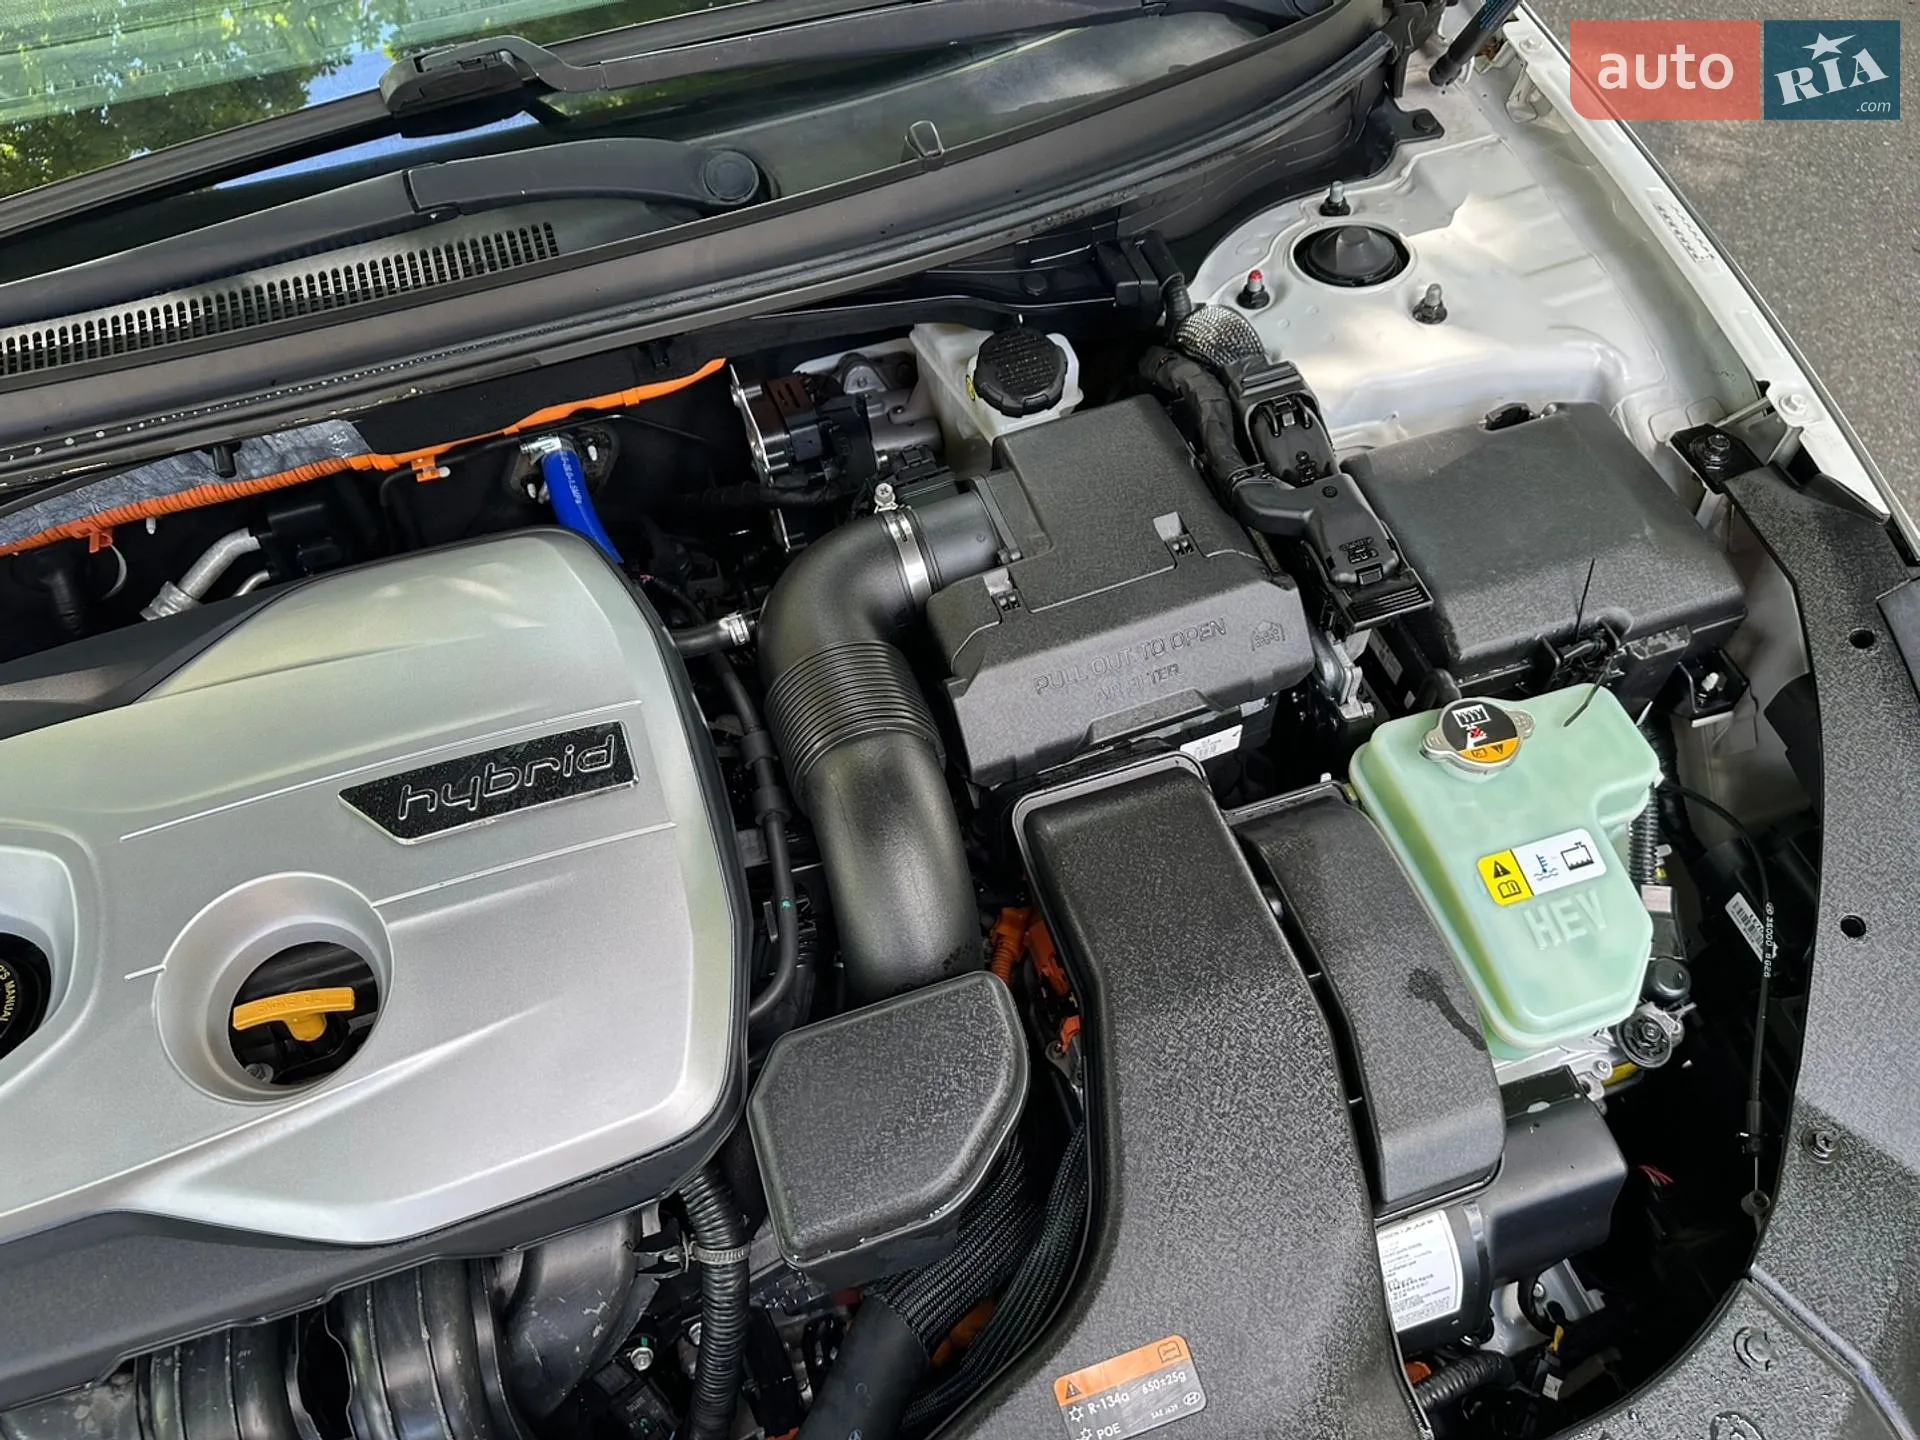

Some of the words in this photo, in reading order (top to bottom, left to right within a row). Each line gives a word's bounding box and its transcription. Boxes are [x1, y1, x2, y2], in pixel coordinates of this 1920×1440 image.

[1033, 665, 1089, 695] PULL
[1090, 649, 1133, 676] OUT
[1139, 637, 1167, 661] TO
[1170, 618, 1227, 650] OPEN
[398, 734, 615, 820] hybrid
[1523, 889, 1607, 951] HEV
[1088, 1391, 1130, 1415] R-134a
[1096, 1422, 1122, 1440] POE
